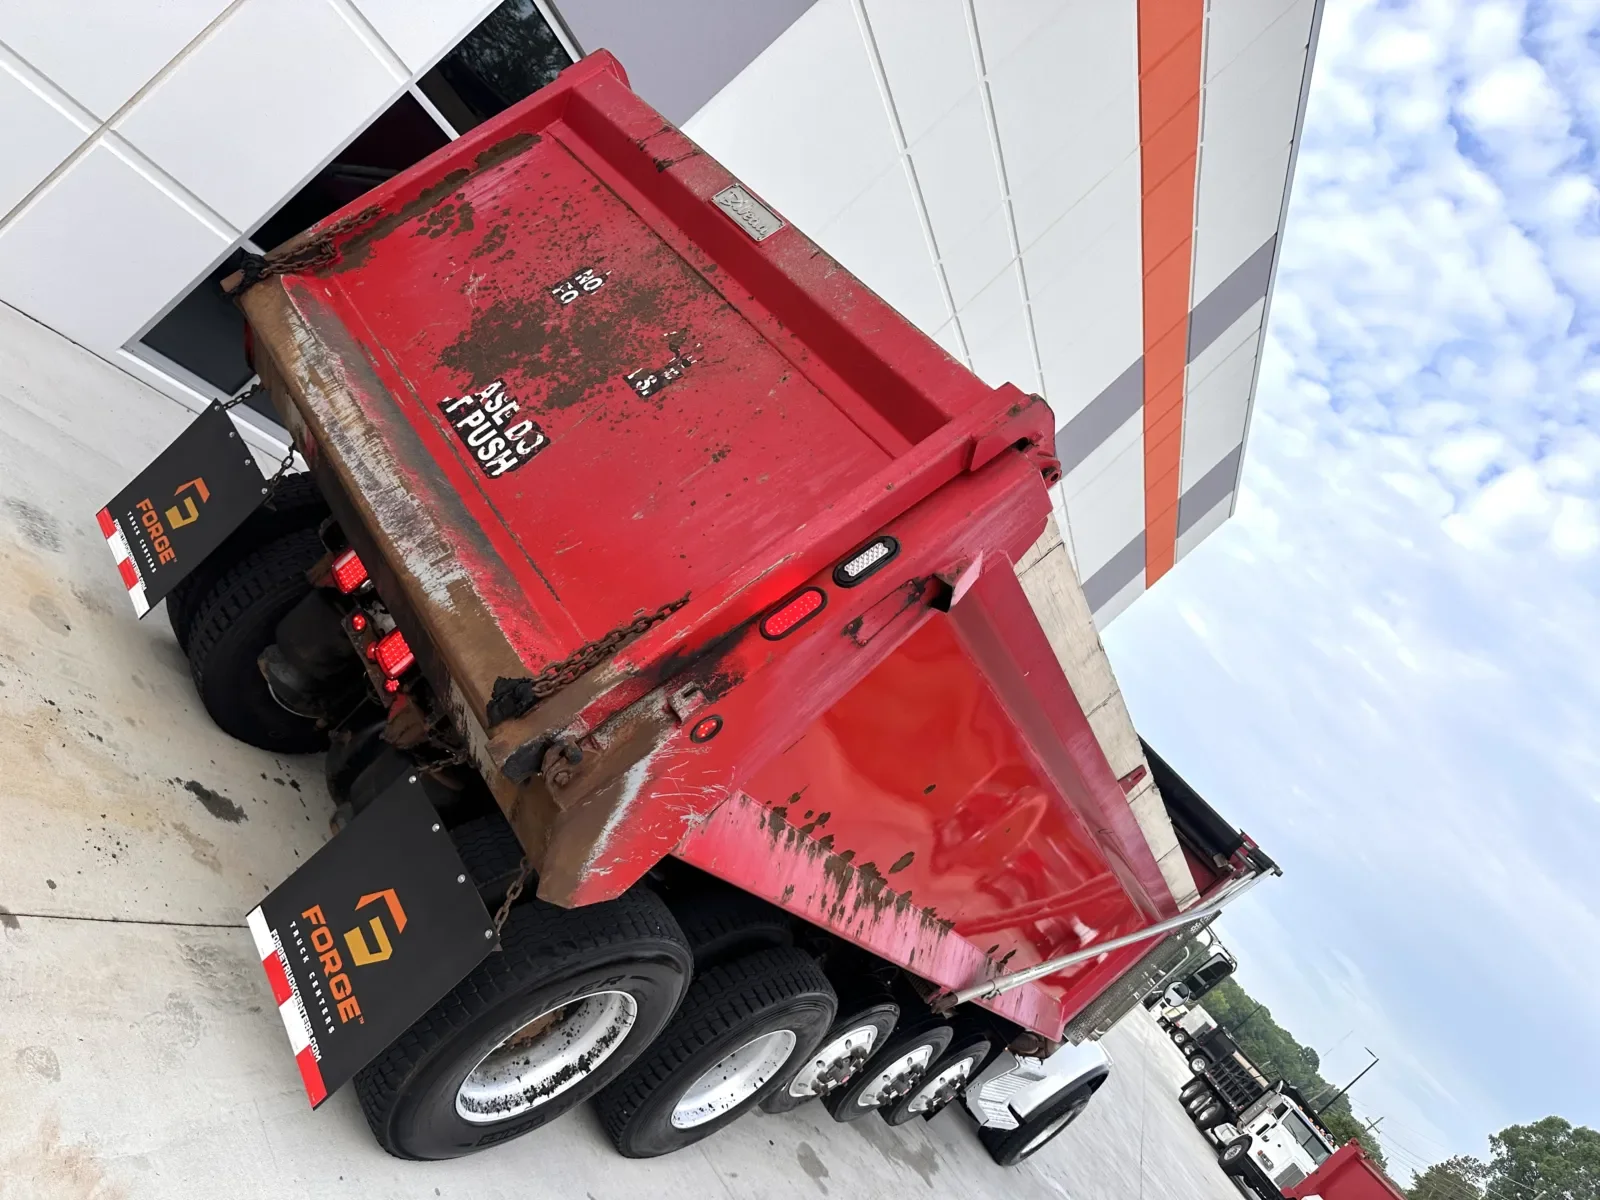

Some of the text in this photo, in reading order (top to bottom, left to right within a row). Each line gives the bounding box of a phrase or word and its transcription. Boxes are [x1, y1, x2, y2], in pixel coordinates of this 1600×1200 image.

[456, 409, 518, 476] PUSH
[127, 510, 157, 573] TRUCK CENTERS
[135, 497, 176, 565] FORGE
[289, 920, 336, 1034] TRUCK CENTERS
[301, 904, 362, 1025] FORGE
